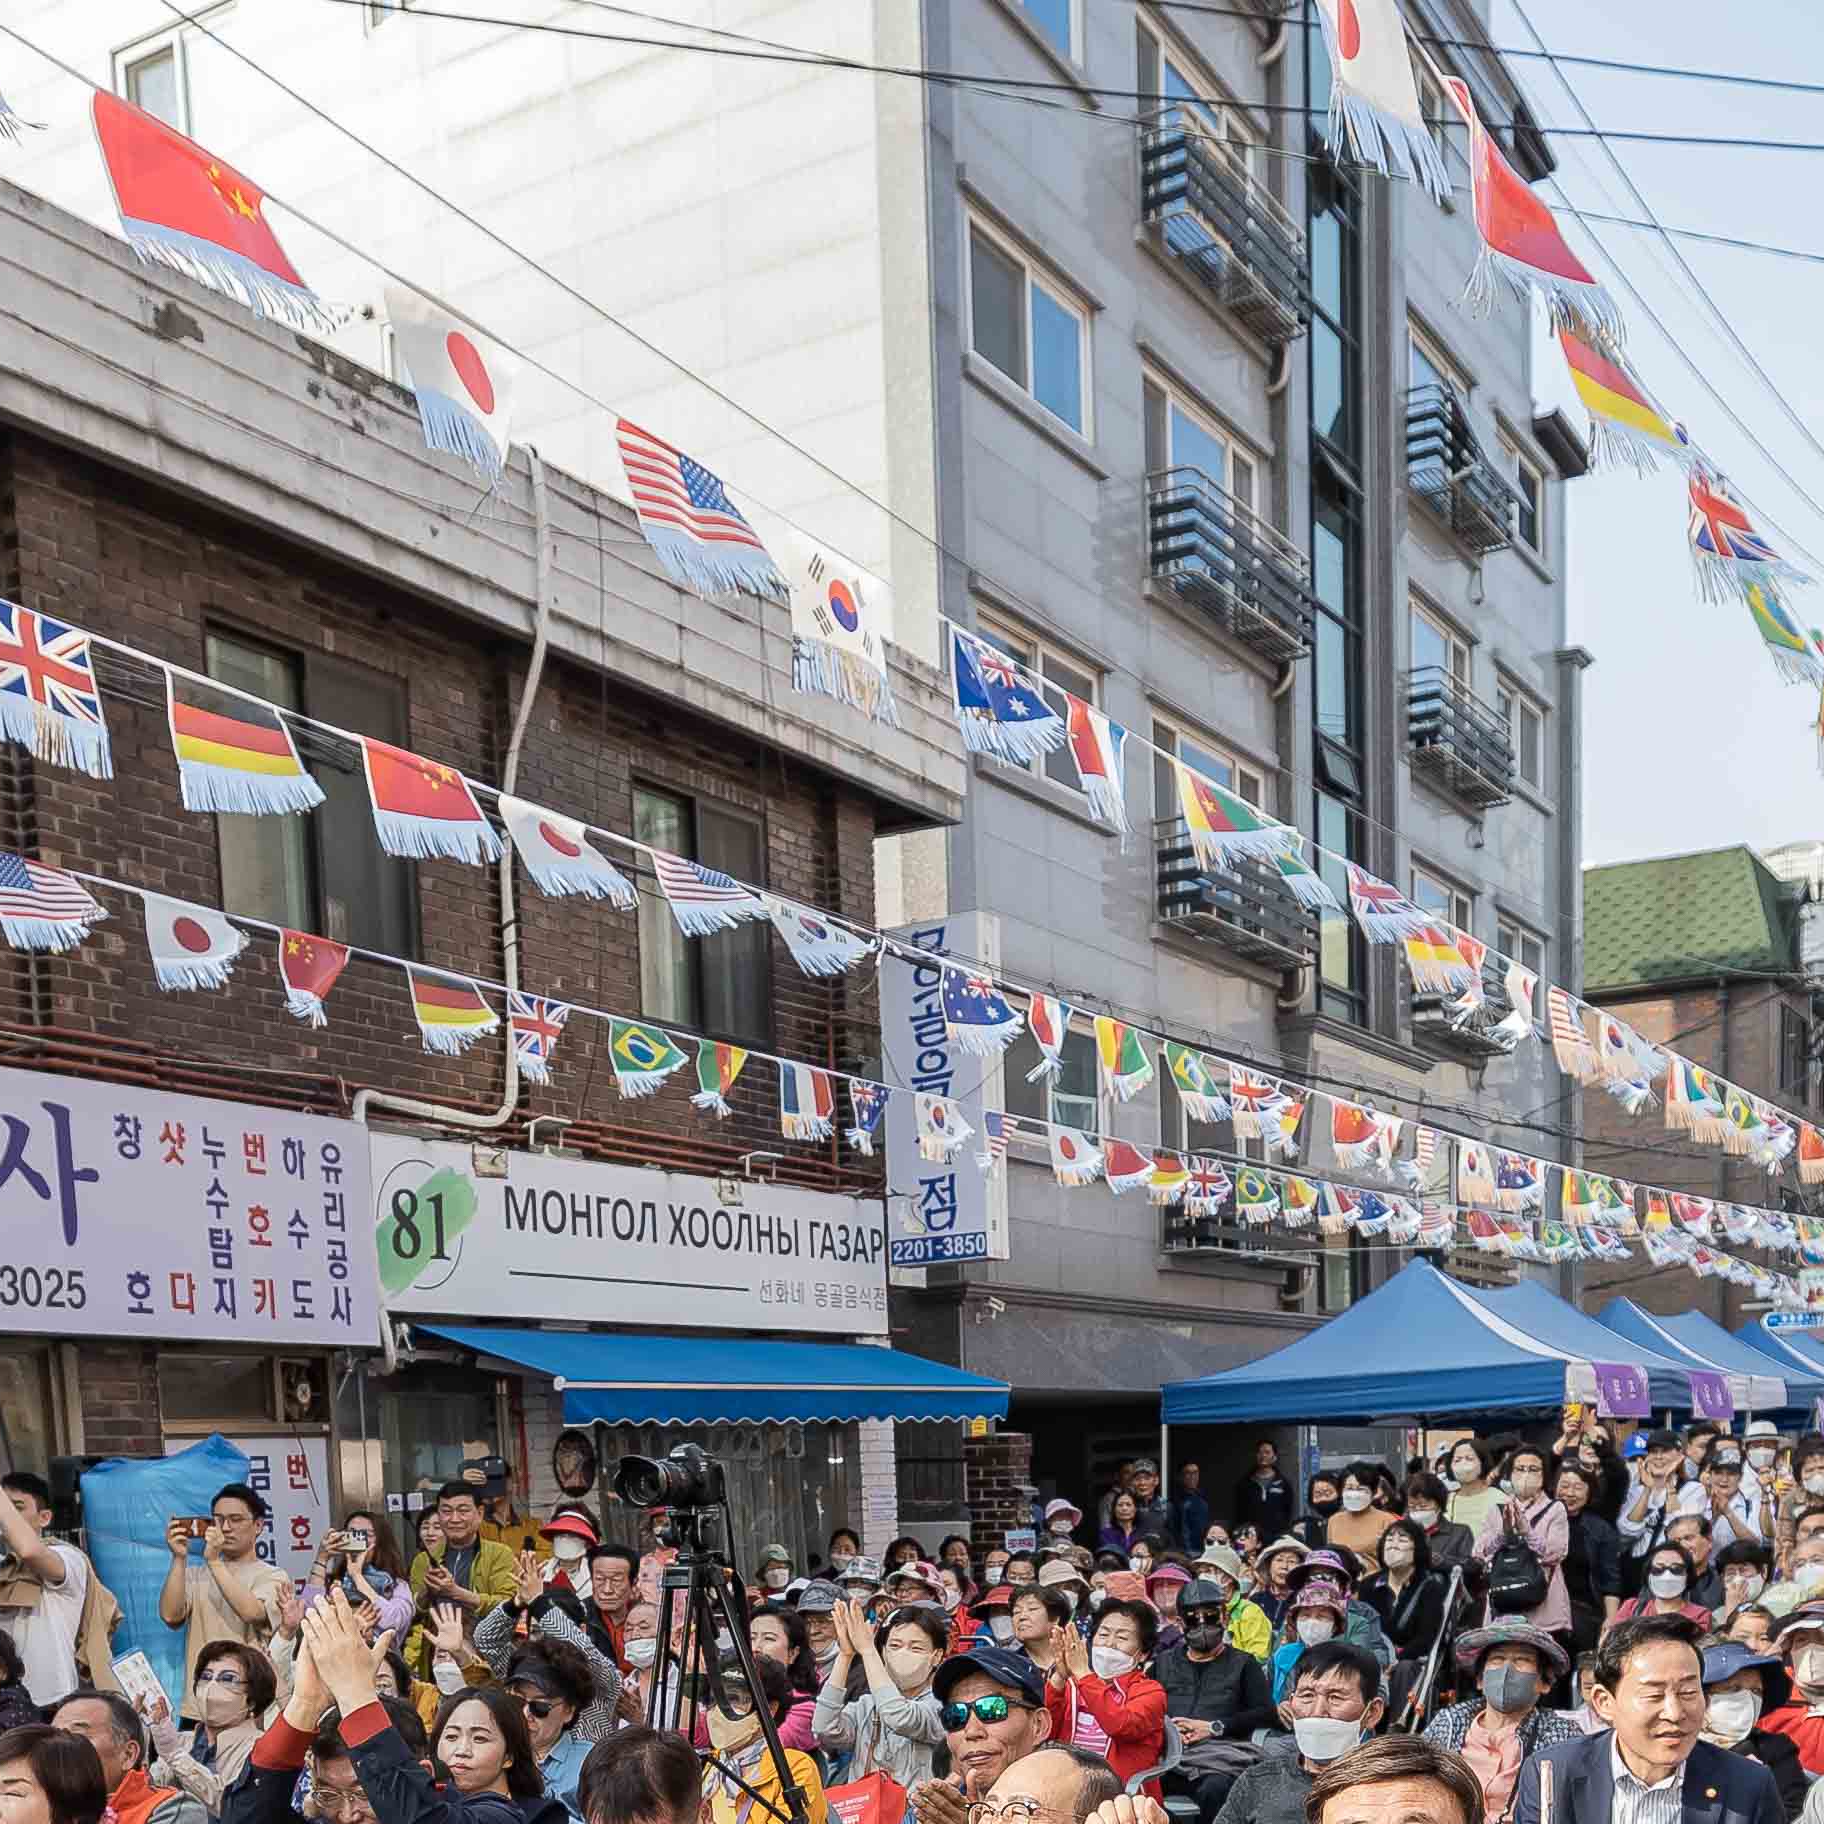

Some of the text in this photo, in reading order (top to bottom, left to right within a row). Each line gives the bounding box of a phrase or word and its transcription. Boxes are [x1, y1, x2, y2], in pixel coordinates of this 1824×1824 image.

[200, 1125, 238, 1320] 누수탐지
[241, 1131, 278, 1321] 번호키
[280, 1137, 316, 1319] 하수도
[318, 1142, 353, 1327] 유리공사
[390, 1188, 448, 1261] 81
[504, 1184, 884, 1265] МОНГОЛ ХООЛНЫ ГАЗАР
[892, 1233, 986, 1263] 2201-3850
[759, 1279, 886, 1312] 선화네 몽골음식점
